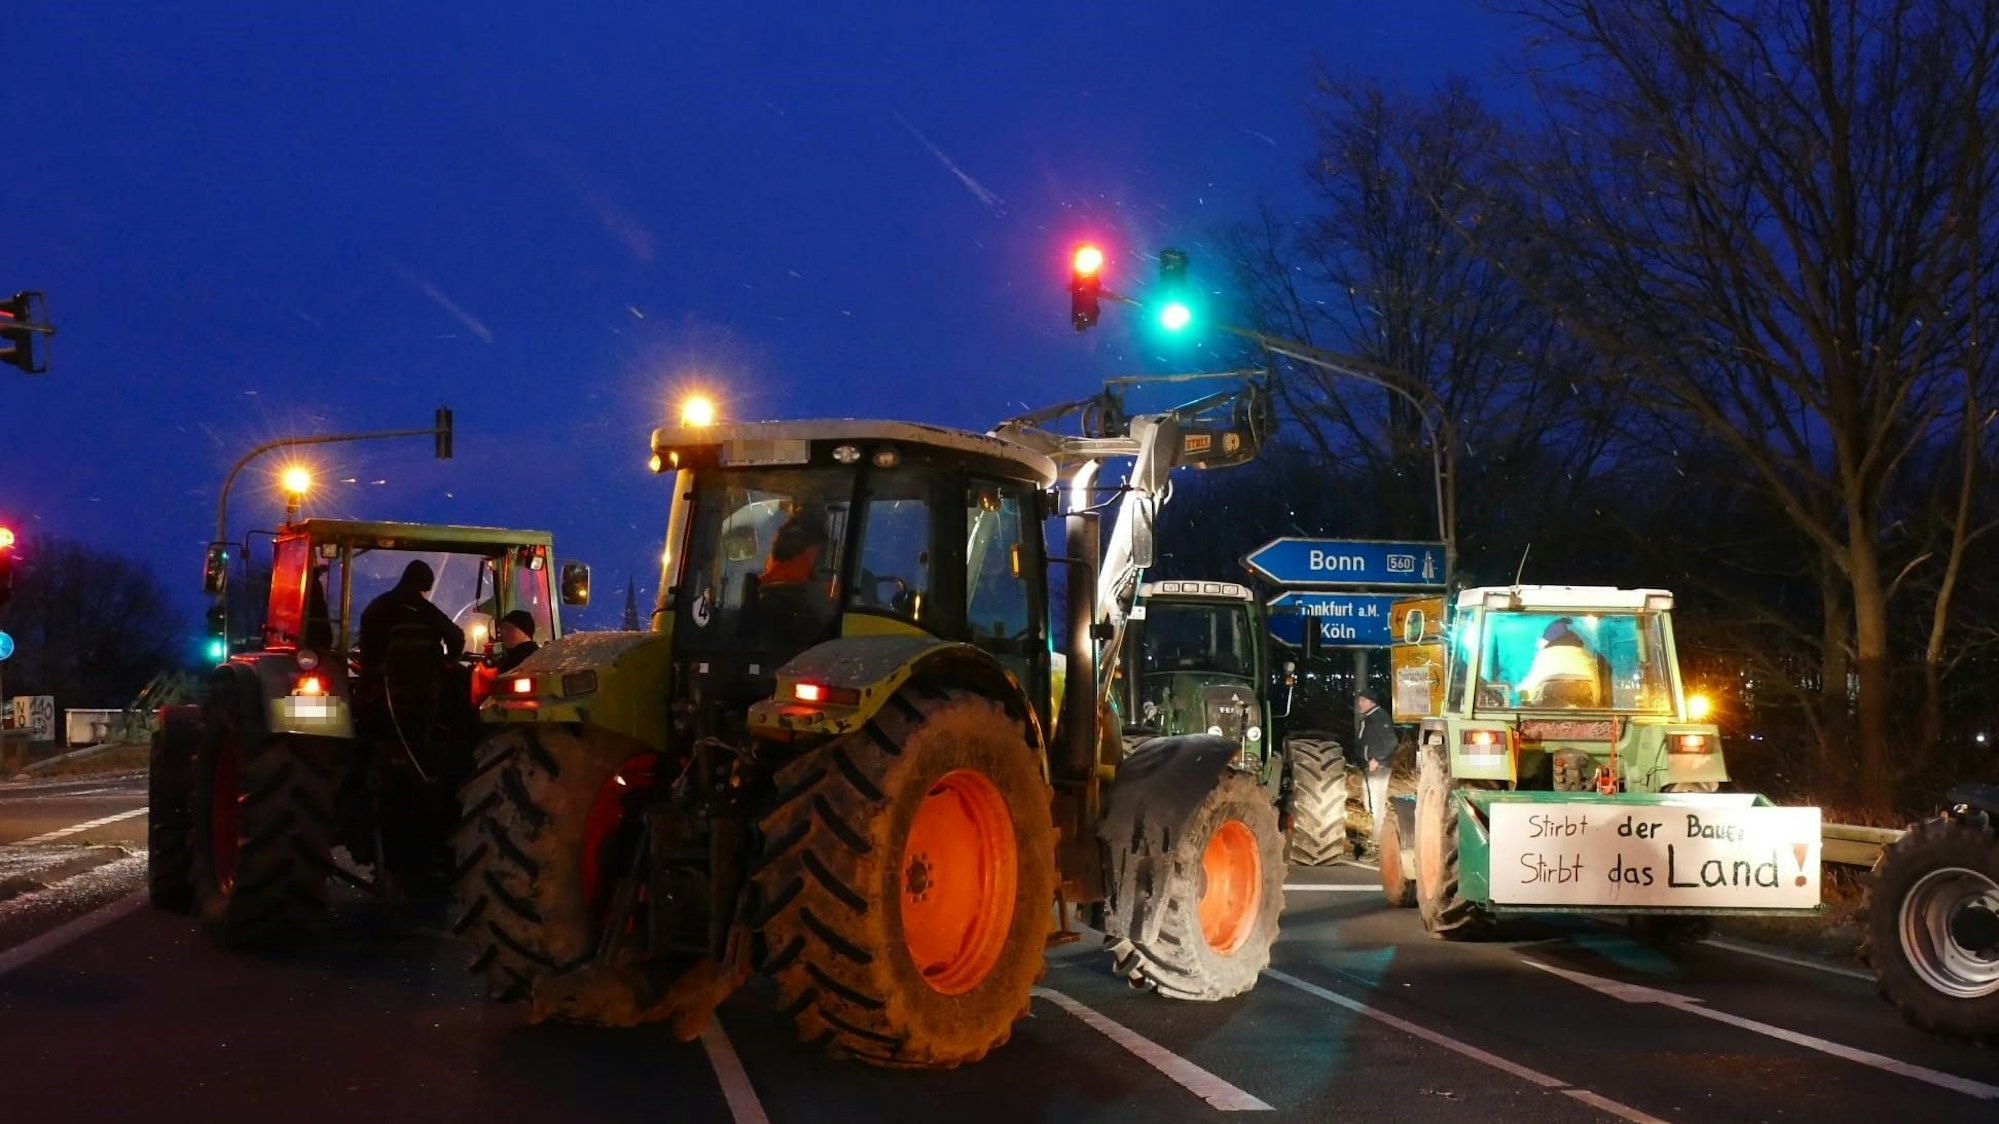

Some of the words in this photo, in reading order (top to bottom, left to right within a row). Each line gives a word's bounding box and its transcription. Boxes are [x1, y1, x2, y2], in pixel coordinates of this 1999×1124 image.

[1309, 549, 1365, 571] Bonn
[1389, 557, 1412, 570] 560
[1358, 604, 1380, 617] a.M.
[1320, 622, 1356, 639] Köln
[1528, 815, 1588, 838] Stirbt
[1618, 815, 1663, 839] der
[1520, 853, 1584, 884] Stirbt
[1608, 854, 1654, 887] das
